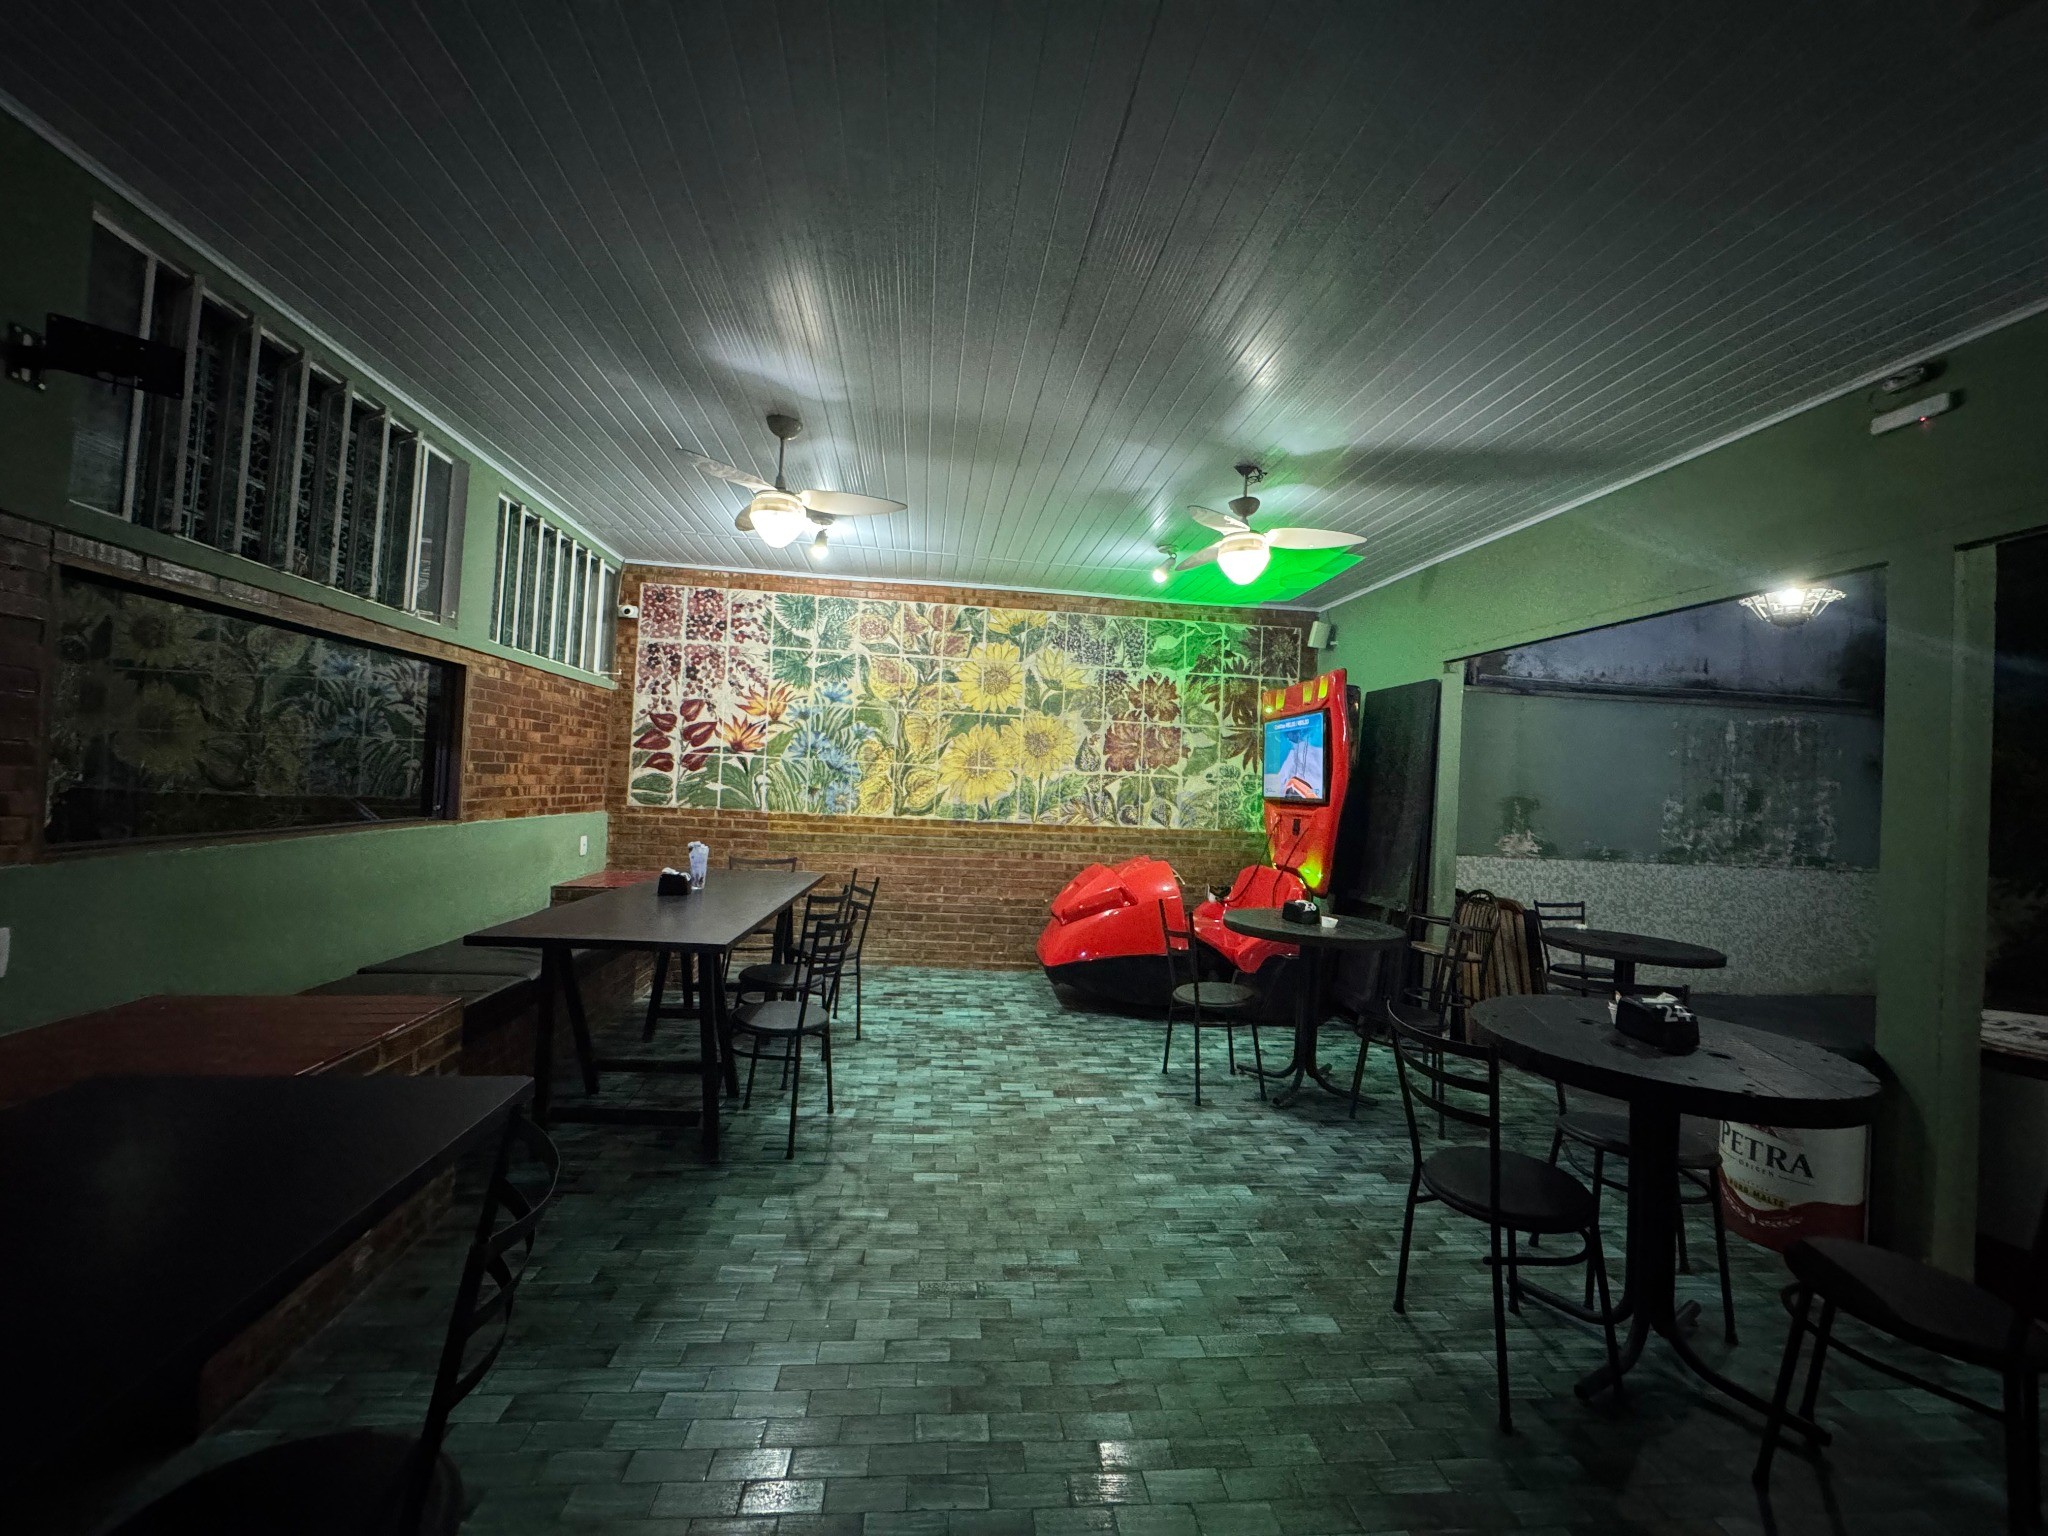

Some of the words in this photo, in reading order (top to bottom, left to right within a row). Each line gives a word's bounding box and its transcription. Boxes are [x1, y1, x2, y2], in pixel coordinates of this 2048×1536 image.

[1656, 1004, 1694, 1023] 24
[1721, 1120, 1814, 1179] PETRA
[1738, 1159, 1775, 1178] ORIGEN
